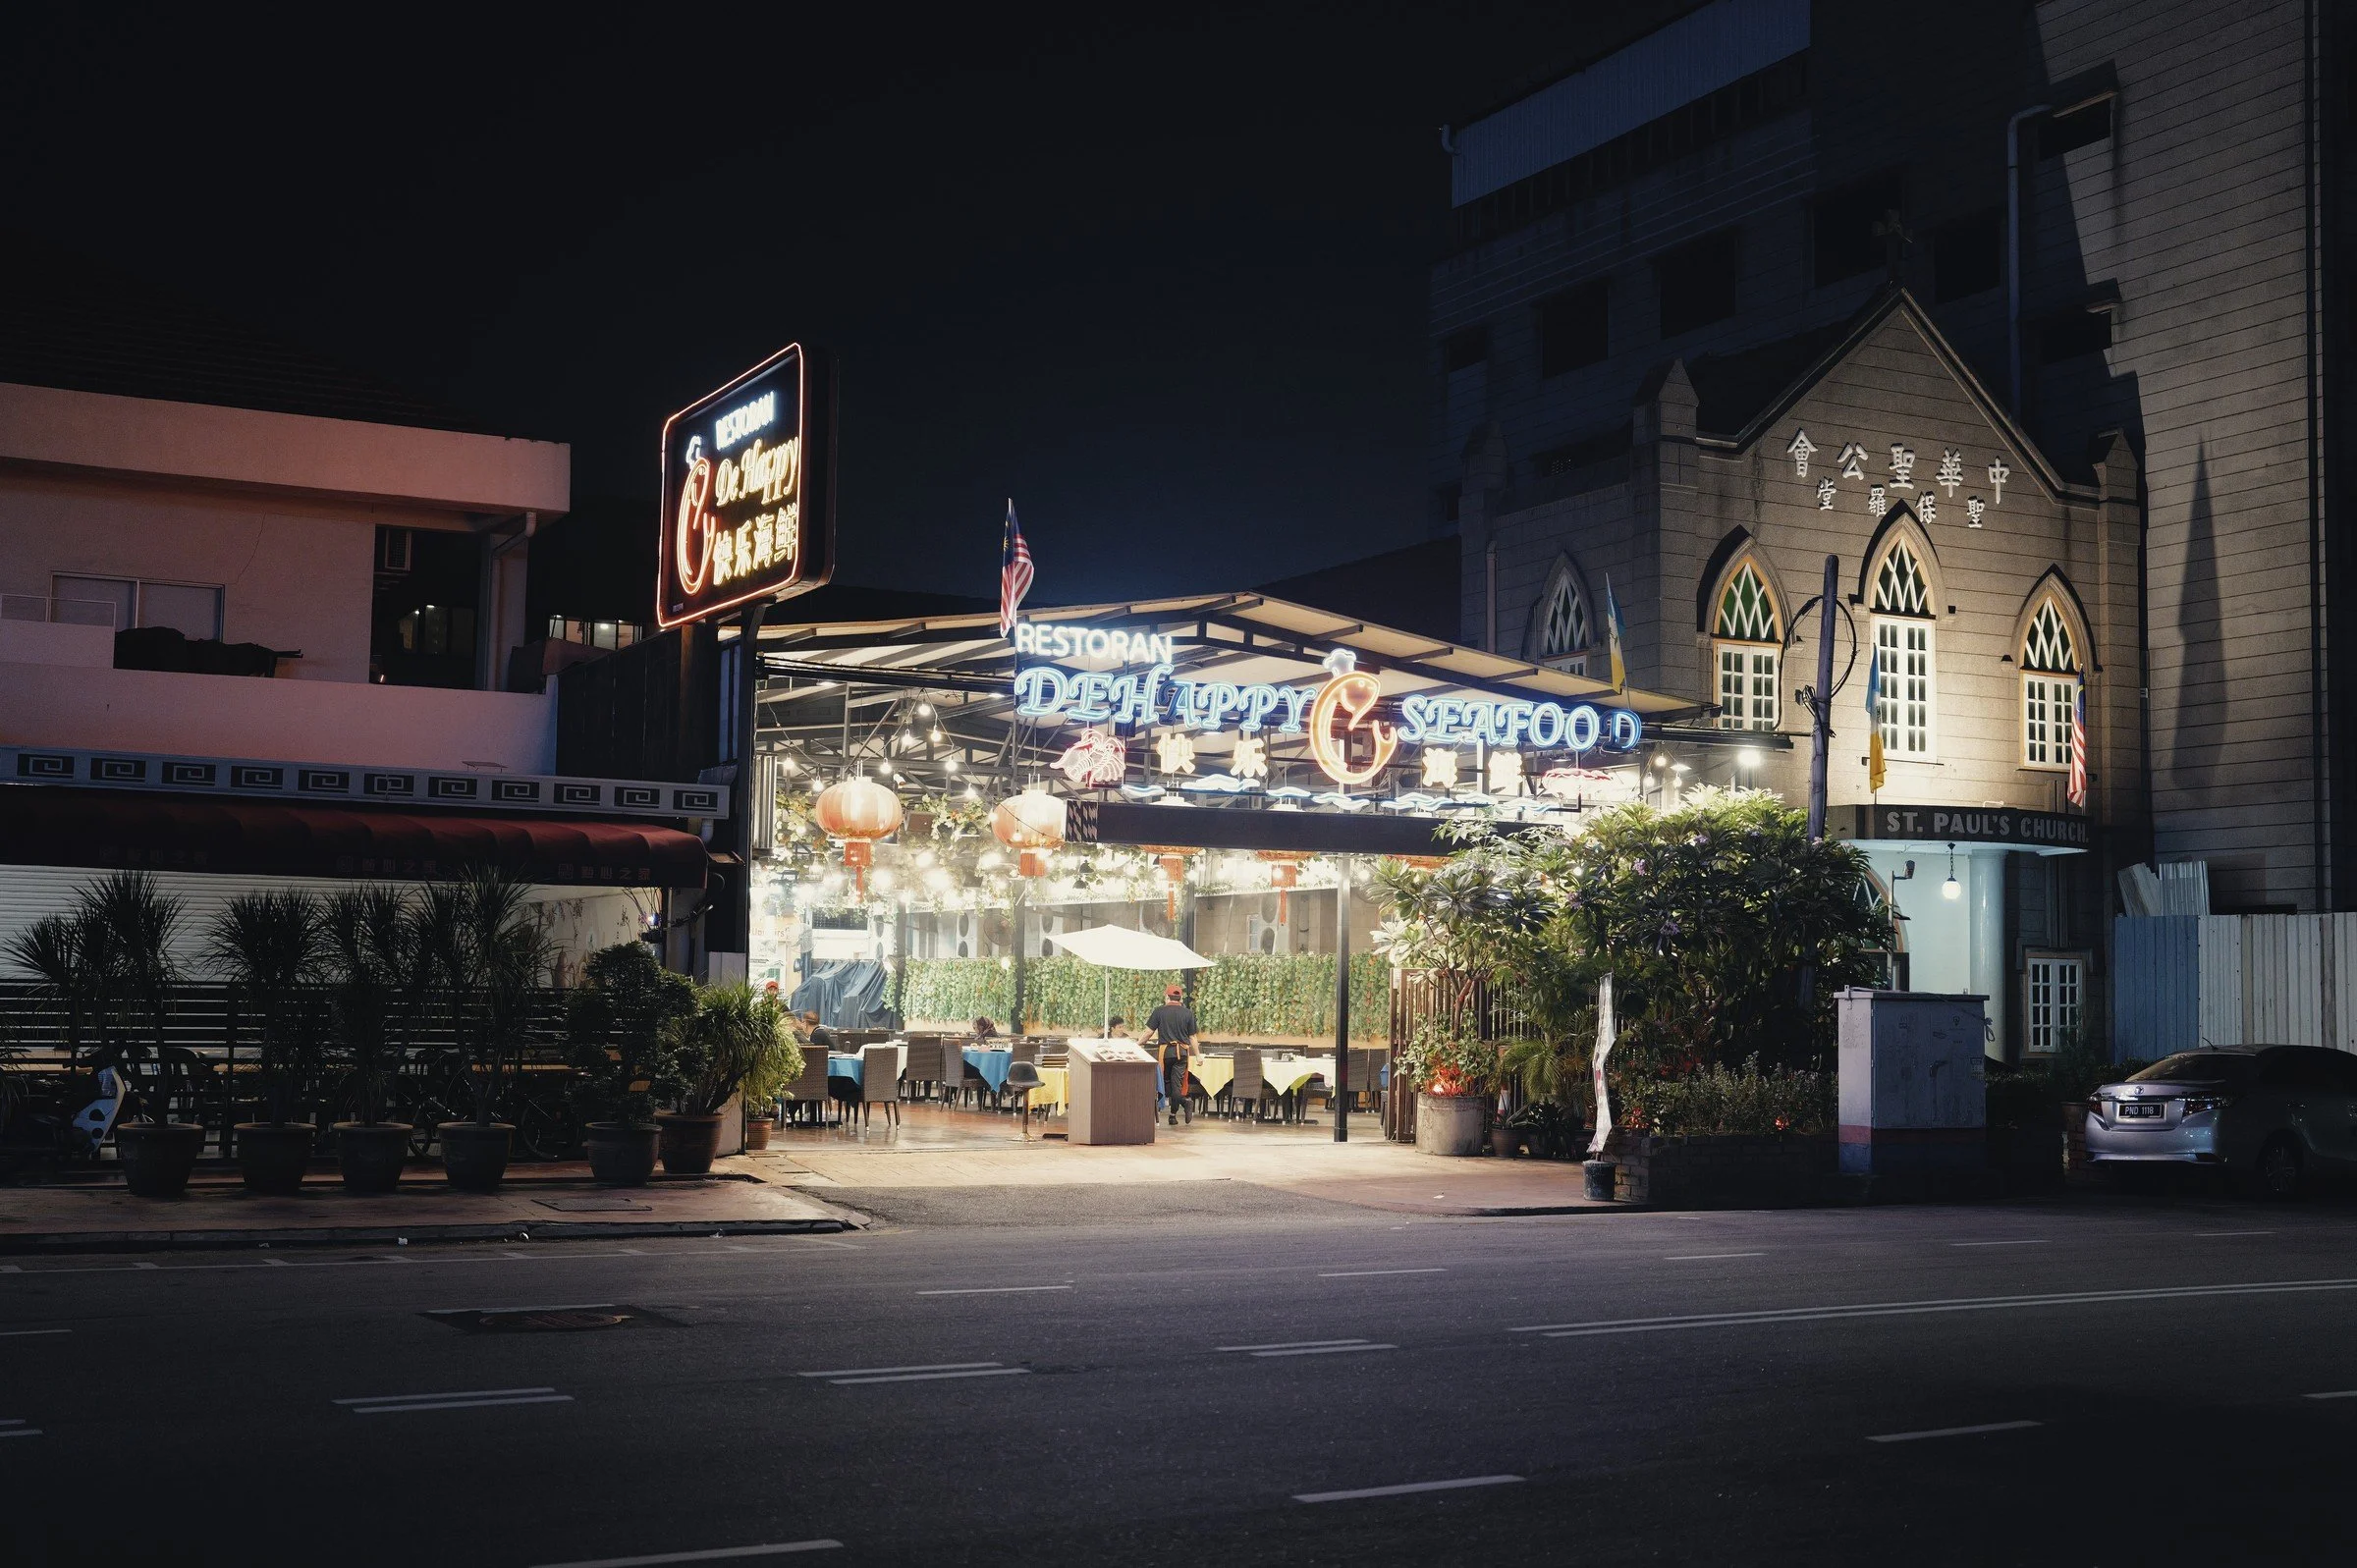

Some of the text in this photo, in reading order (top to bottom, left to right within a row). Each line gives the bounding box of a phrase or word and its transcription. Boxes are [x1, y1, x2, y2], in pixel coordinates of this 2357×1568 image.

[715, 391, 774, 451] RESTORAN
[715, 437, 799, 507] De Happy
[1016, 622, 1173, 664] RESTORAN
[1397, 693, 1642, 754] SEAFOOD
[1887, 811, 1924, 833] ST.
[1934, 812, 2010, 836] PAUL'S
[2141, 1106, 2155, 1115] 1118
